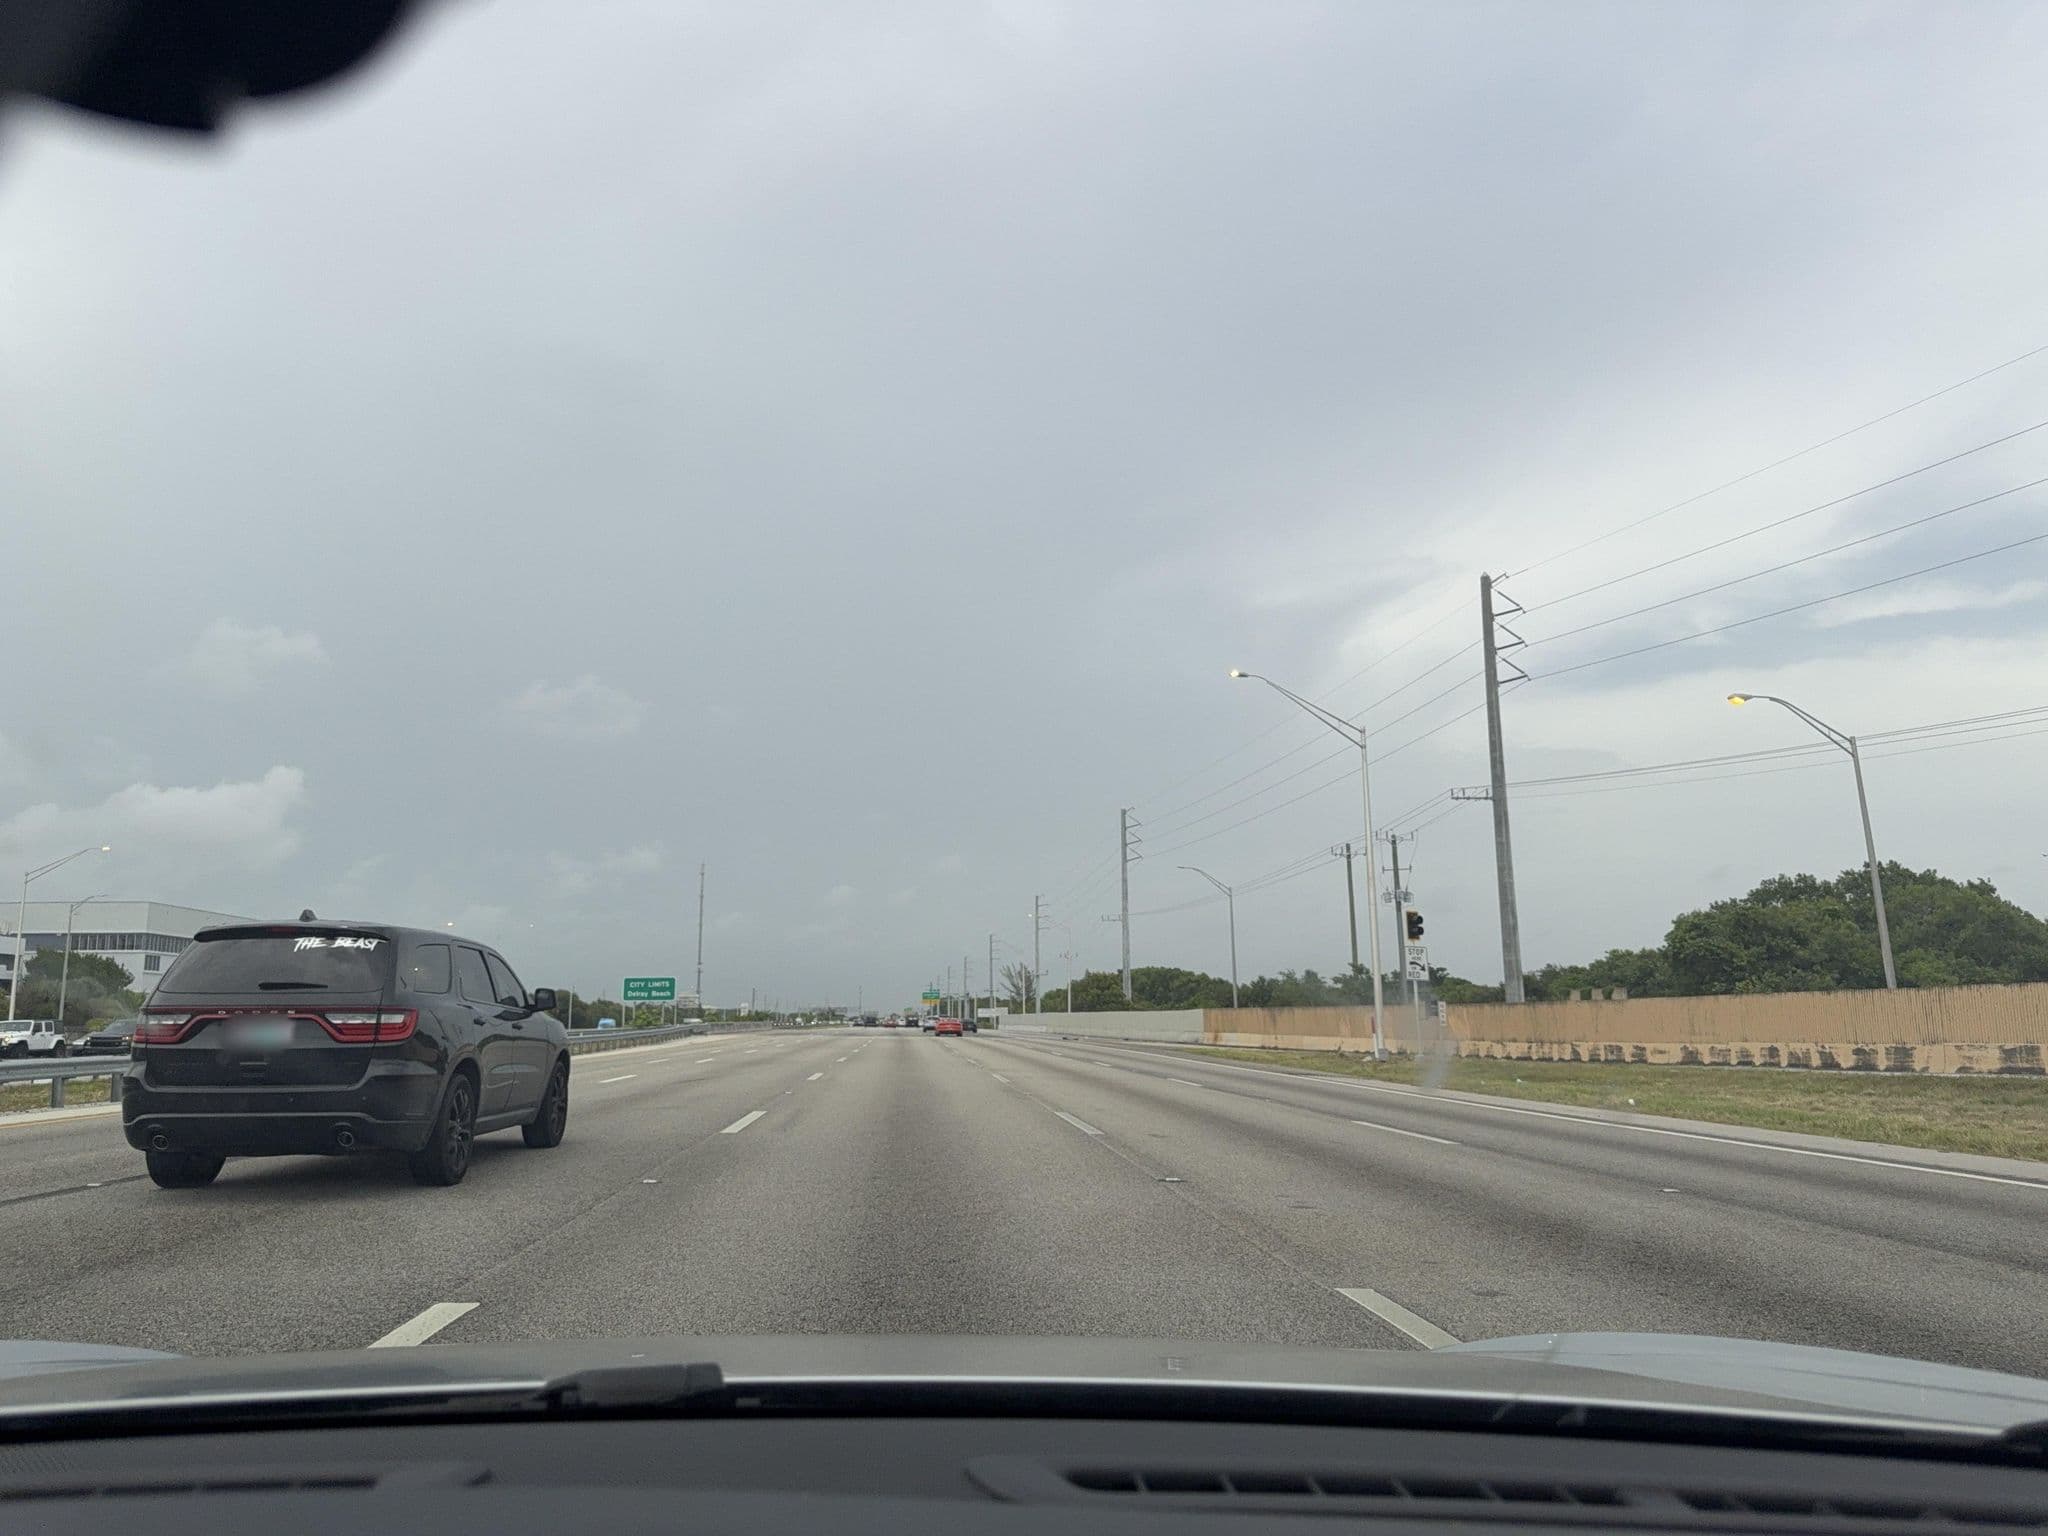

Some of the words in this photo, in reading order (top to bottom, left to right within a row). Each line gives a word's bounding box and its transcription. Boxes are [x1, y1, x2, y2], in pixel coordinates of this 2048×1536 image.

[293, 936, 327, 952] THE
[329, 936, 387, 951] BEAST
[1407, 948, 1424, 956] STOP
